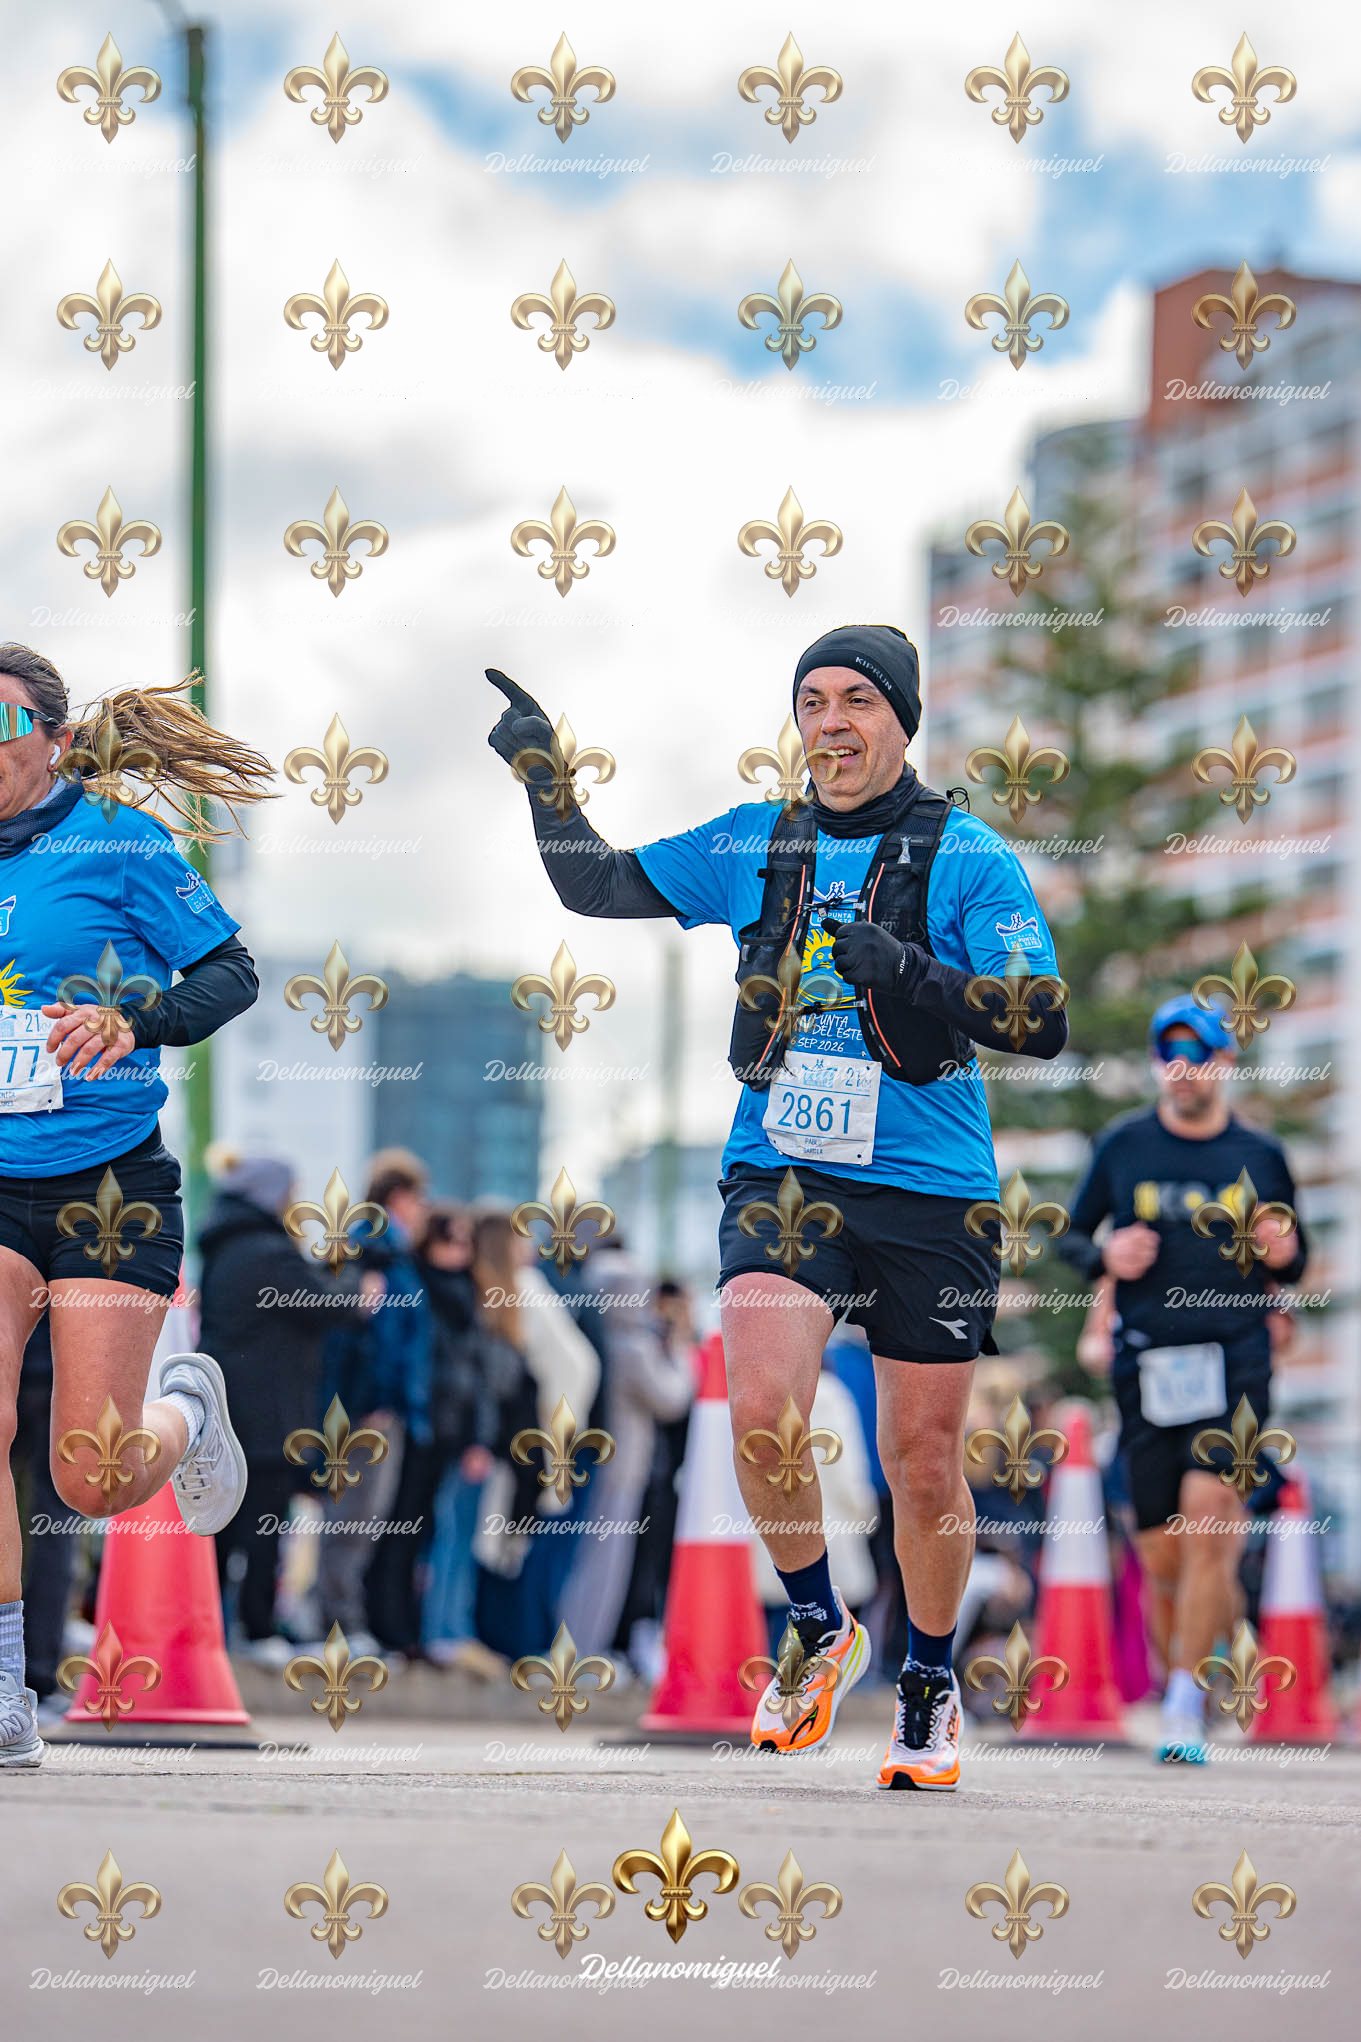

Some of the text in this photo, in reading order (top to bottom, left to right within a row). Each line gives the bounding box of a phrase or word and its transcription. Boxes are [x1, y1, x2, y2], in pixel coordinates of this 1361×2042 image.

[855, 656, 892, 690] KIPRUN
[25, 1012, 39, 1033] 21
[798, 1037, 817, 1048] SEP
[817, 1040, 845, 1052] 2026
[836, 1027, 863, 1041] ESTE
[777, 1091, 851, 1134] 2861
